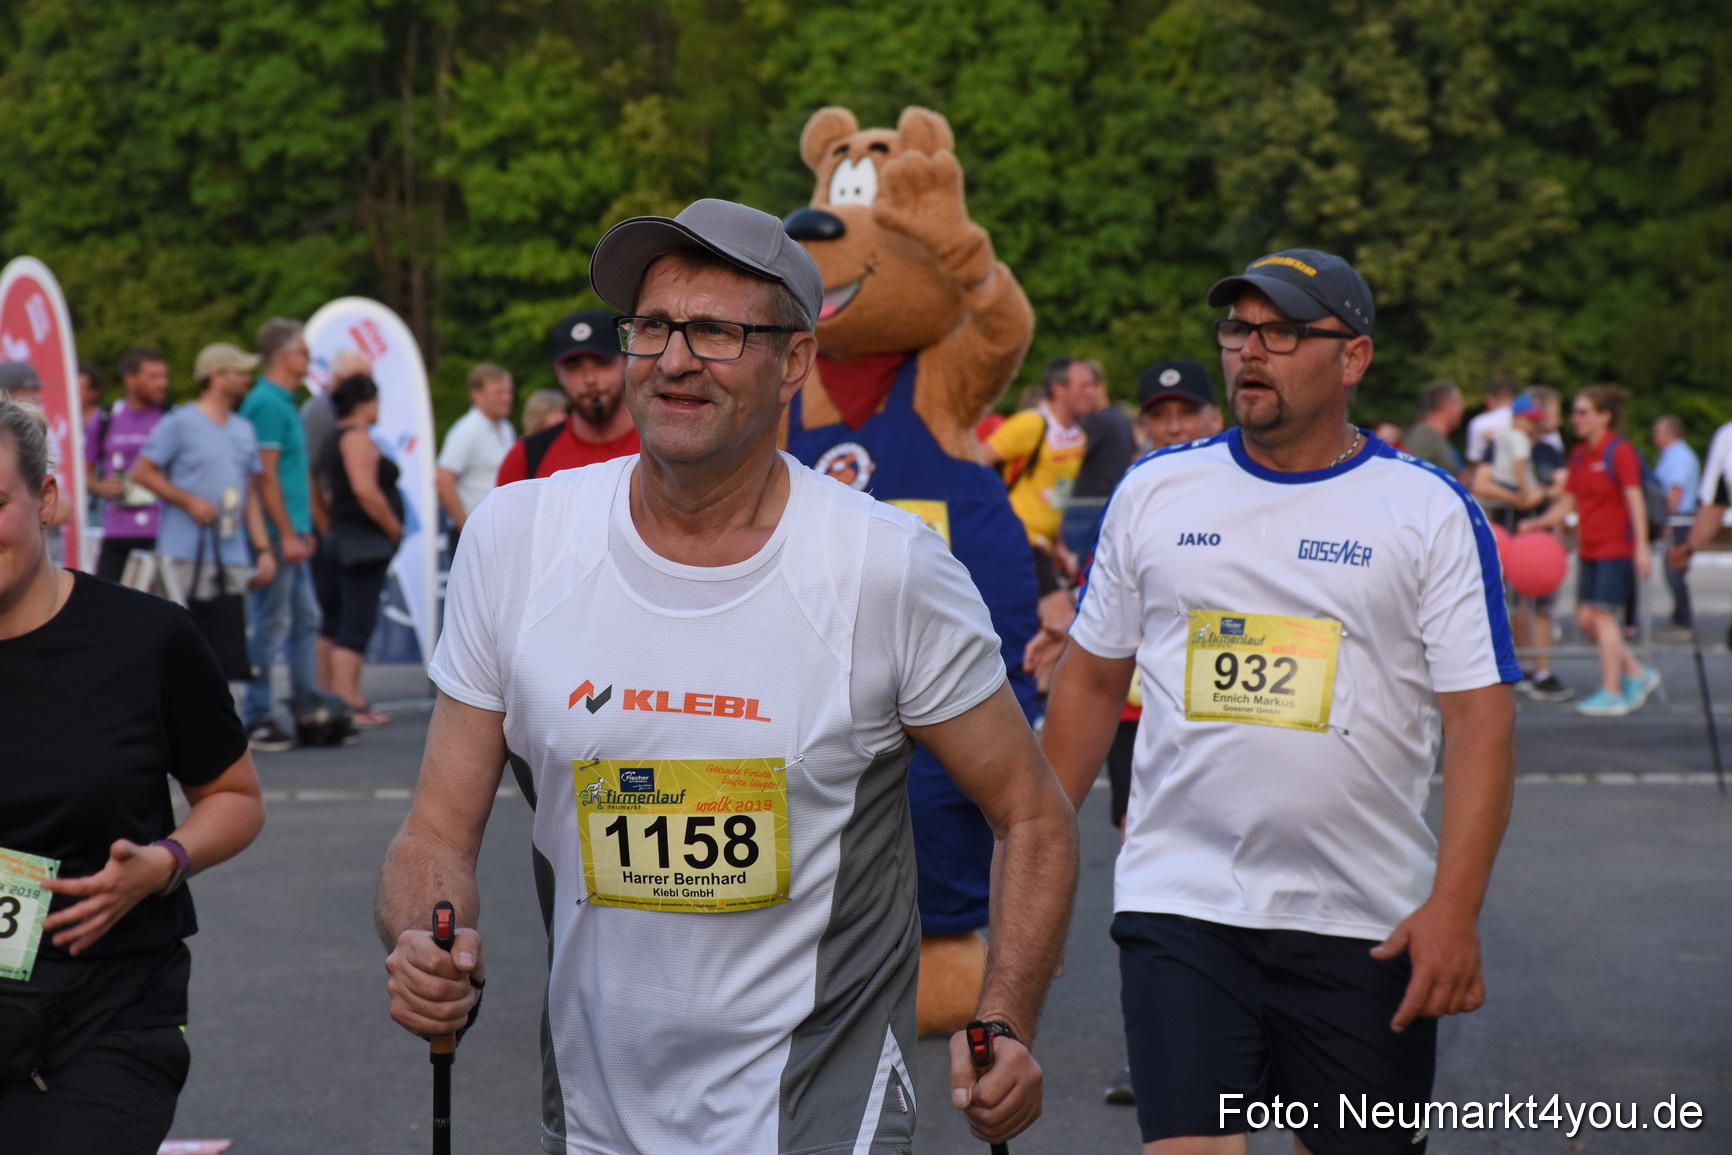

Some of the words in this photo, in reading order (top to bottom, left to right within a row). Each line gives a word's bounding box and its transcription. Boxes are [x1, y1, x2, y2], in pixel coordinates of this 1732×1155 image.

[1177, 533, 1221, 546] JAKO
[1298, 539, 1372, 567] GOSSNER
[1208, 632, 1267, 647] firmenlauf
[1214, 652, 1299, 696] 932
[622, 688, 772, 722] KLEBL
[1213, 692, 1250, 705] Ennich
[1253, 693, 1295, 709] Markus
[1223, 704, 1254, 714] Gossner
[1256, 706, 1281, 715] GmbH
[621, 771, 649, 782] Fischer
[706, 763, 742, 775] Gesunde
[743, 768, 772, 779] Firmen
[721, 775, 747, 787] laufen
[607, 789, 687, 804] firmenlauf
[696, 795, 732, 813] walk
[735, 799, 773, 813] 2019
[605, 815, 759, 870] 1158
[623, 871, 669, 886] Harrer
[674, 872, 746, 886] Bernhard
[9, 885, 41, 899] 2019
[653, 888, 679, 898] Klebl
[682, 888, 715, 898] GmbH
